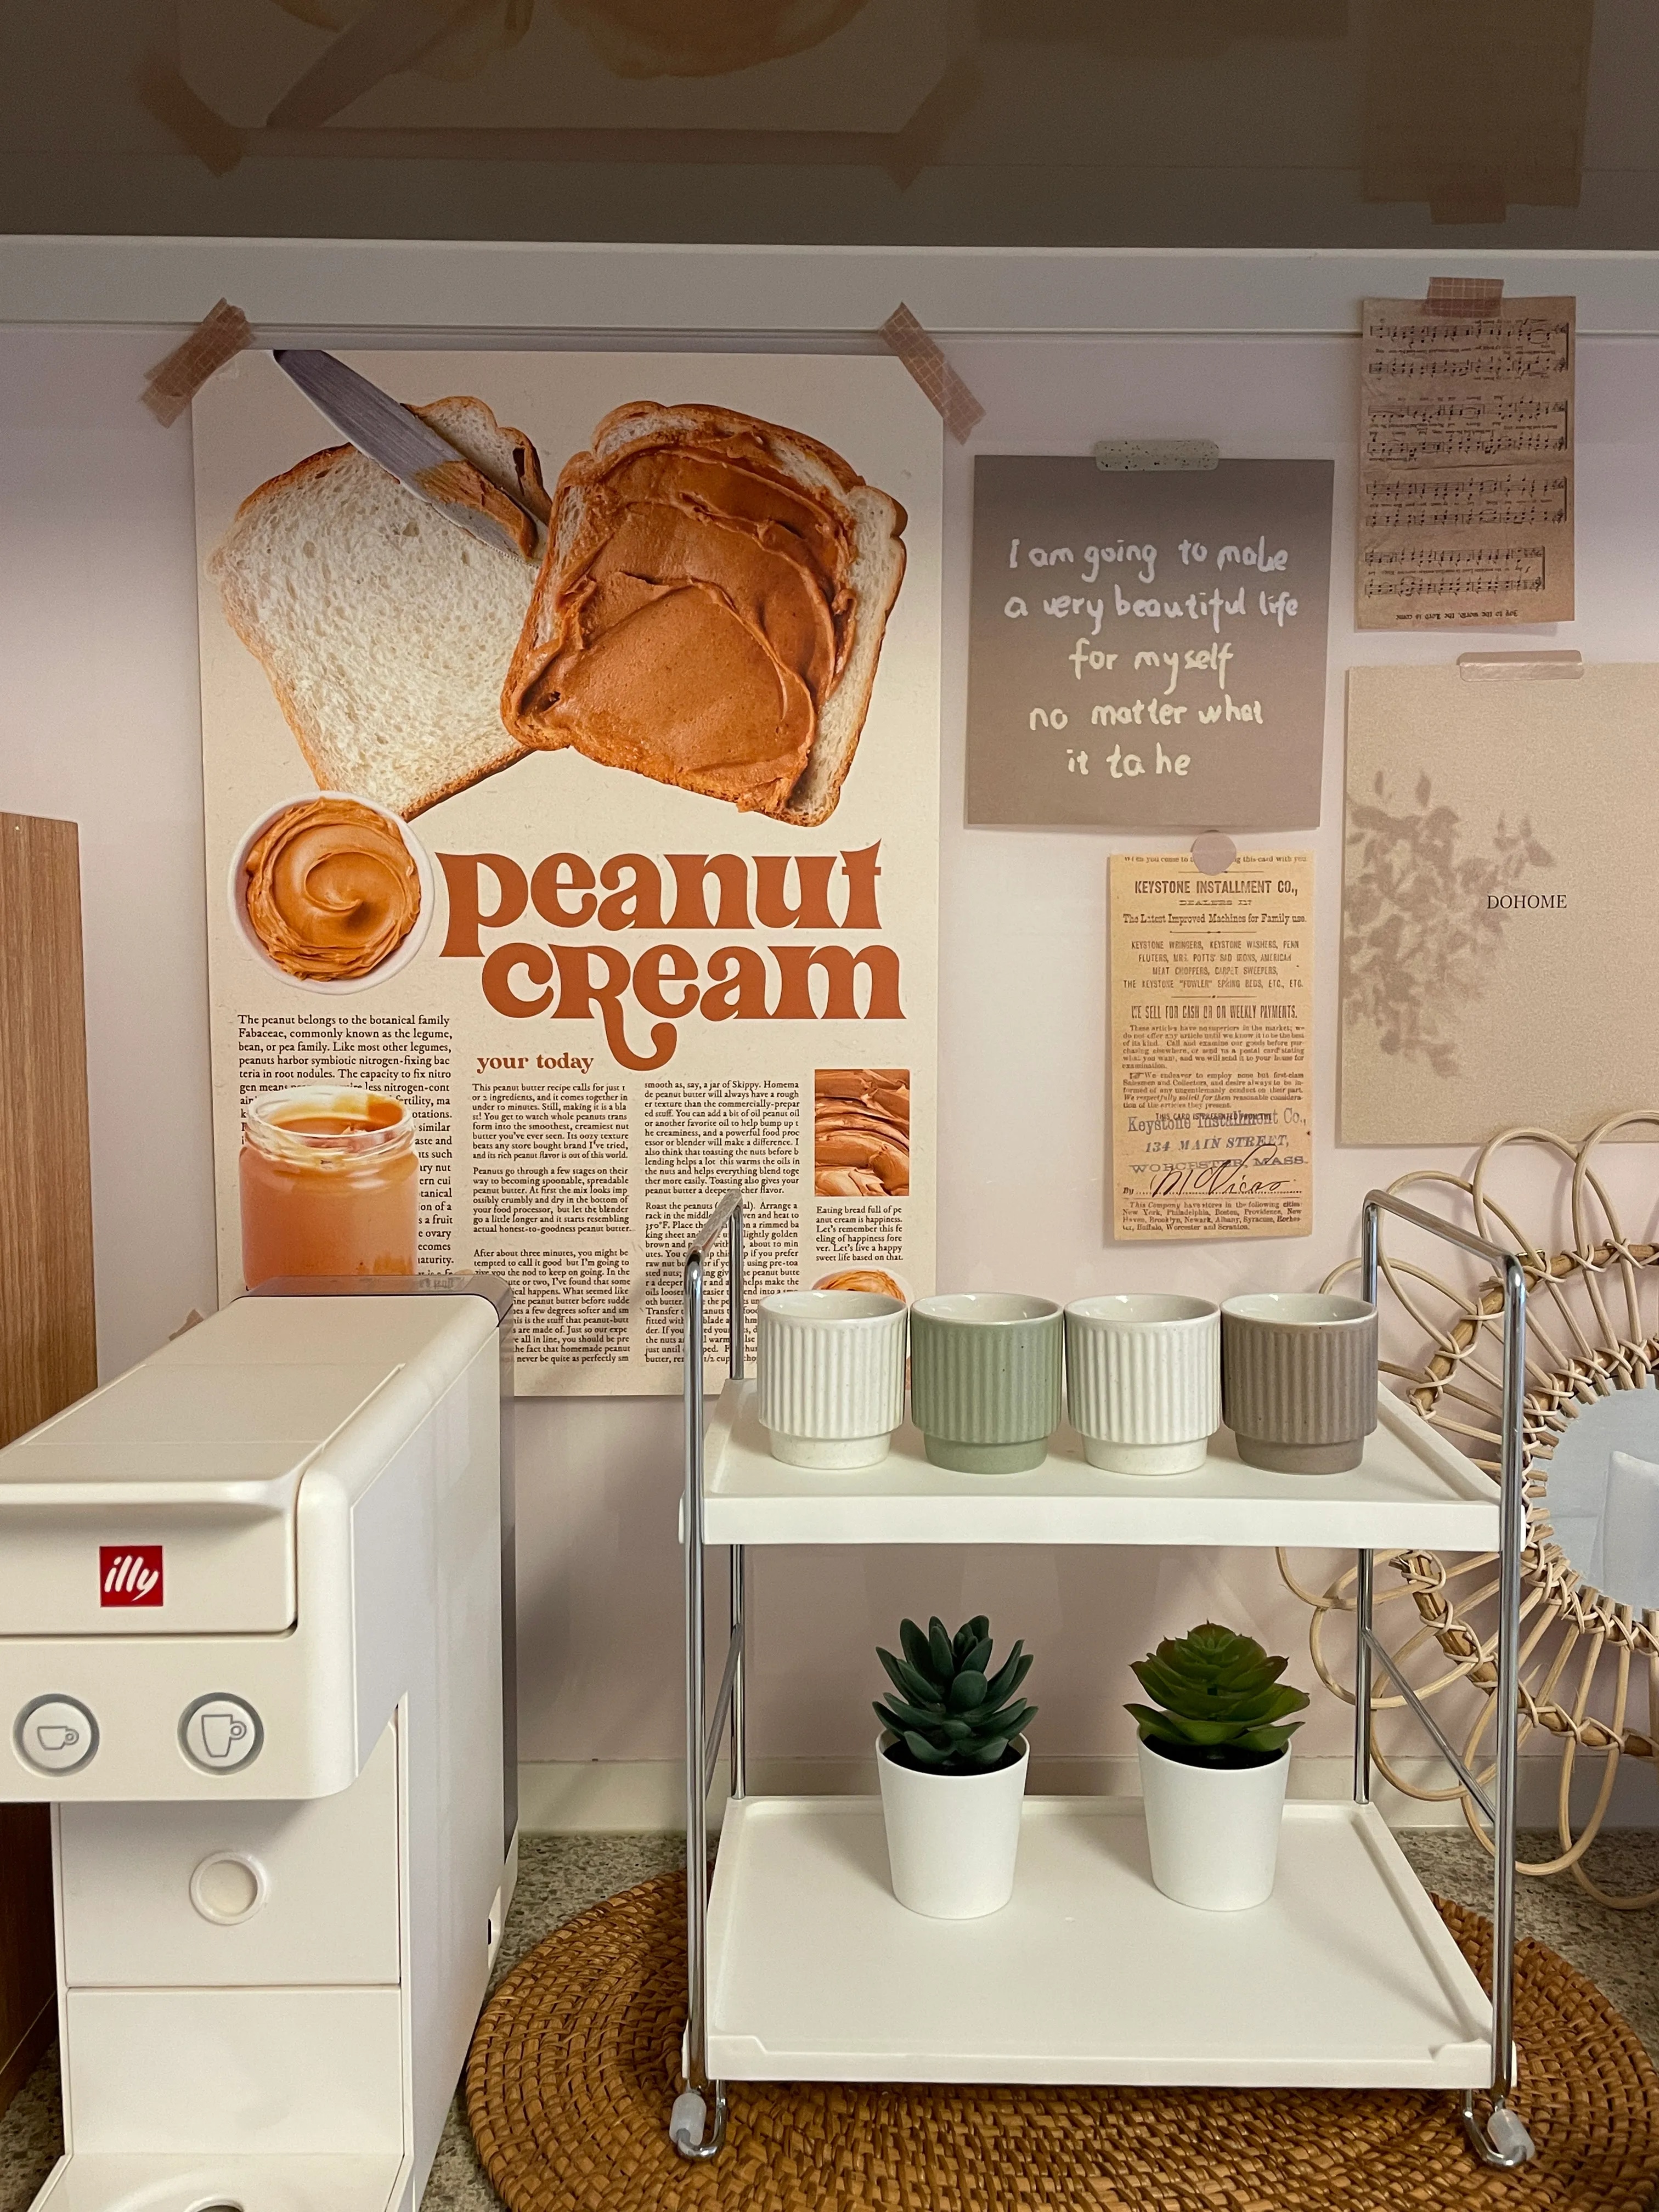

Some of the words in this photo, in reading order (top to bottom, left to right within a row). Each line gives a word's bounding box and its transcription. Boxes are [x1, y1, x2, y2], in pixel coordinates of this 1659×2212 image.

[1009, 538, 1020, 569] I
[1029, 546, 1074, 567] am
[1081, 540, 1157, 583] going
[1178, 539, 1207, 565] to
[1004, 597, 1028, 618] a
[1043, 595, 1104, 635] very
[1115, 585, 1245, 634] beautiful
[1259, 591, 1299, 628] life
[1068, 638, 1119, 680] for
[1029, 707, 1068, 731] no
[1091, 699, 1187, 726] matter
[1198, 694, 1263, 725] what
[1066, 749, 1089, 775] it
[1135, 881, 1190, 894] KEYSTONE
[1197, 881, 1272, 894] INSTALLMENT
[1278, 881, 1297, 896] CO.,
[434, 838, 882, 957] peanut
[1487, 895, 1567, 909] DOHOME
[1123, 913, 1138, 923] The
[1141, 914, 1166, 923] Latest
[1168, 913, 1206, 926] Improved
[1209, 913, 1246, 923] Machines
[1248, 913, 1259, 923] for
[1261, 913, 1290, 926] Family
[1153, 967, 1170, 975] MEAT
[1175, 967, 1210, 975] CHOPPERS,
[1215, 967, 1238, 975] CARPET
[1243, 967, 1278, 975] SWEEPERS,
[1131, 1005, 1142, 1019] WE
[1146, 1005, 1161, 1019] SELL
[1165, 1006, 1178, 1019] FOR
[1183, 1005, 1199, 1019] CASH
[1203, 1005, 1212, 1019] OR
[1216, 1005, 1226, 1019] ON
[1230, 1005, 1256, 1019] WEEKLY
[1260, 1005, 1297, 1019] PAYMENTS.
[237, 1015, 259, 1024] The
[262, 1018, 295, 1027] peanut
[298, 1015, 336, 1027] belongs
[352, 1015, 367, 1024] the
[370, 1015, 415, 1024] botanical
[418, 1015, 450, 1027] family
[238, 1028, 287, 1039] Fabaceae,
[290, 1028, 343, 1040] commonly
[346, 1028, 379, 1038] known
[394, 1028, 410, 1038] the
[413, 1028, 453, 1040] legume,
[239, 1042, 264, 1054] bean,
[279, 1045, 295, 1054] pea
[297, 1042, 330, 1054] family.
[332, 1042, 355, 1051] Like
[382, 1042, 408, 1052] other
[410, 1042, 452, 1054] legumes,
[239, 1058, 275, 1067] peanuts
[277, 1055, 309, 1065] harbor
[311, 1055, 357, 1067] symbiotic
[359, 1055, 432, 1067] nitrogen-fixing
[434, 1056, 450, 1065] bac
[477, 1054, 528, 1074] your
[537, 1052, 594, 1074] today
[240, 1069, 261, 1077] teria
[263, 1069, 272, 1078] in
[297, 1069, 335, 1078] nodules.
[337, 1069, 358, 1078] The
[360, 1069, 399, 1081] capacity
[414, 1069, 426, 1078] fix
[428, 1069, 451, 1078] nitro
[521, 1083, 545, 1091] butter
[548, 1084, 571, 1093] recipe
[573, 1083, 590, 1091] calls
[592, 1083, 604, 1091] for
[605, 1084, 619, 1093] just
[732, 1080, 761, 1090] Skippy.
[490, 1093, 535, 1103] ingredients,
[553, 1093, 558, 1102] it
[586, 1093, 618, 1103] together
[620, 1093, 628, 1102] in
[1128, 1116, 1190, 1134] Keystone
[1146, 1142, 1170, 1153] 134
[1178, 1138, 1221, 1150] MAIN
[1226, 1135, 1289, 1148] STREET,
[1130, 1159, 1248, 1172] WORCESTER,
[1123, 1187, 1134, 1195] By
[816, 1206, 843, 1215] Eating
[866, 1215, 902, 1224] happiness.
[816, 1224, 836, 1233] Let's
[838, 1224, 877, 1233] remember
[879, 1224, 894, 1232] this
[895, 1224, 902, 1232] fe
[816, 1234, 836, 1244] eling
[837, 1234, 847, 1242] of
[847, 1234, 884, 1244] happiness
[855, 1243, 870, 1251] live
[878, 1243, 902, 1253] happy
[104, 1555, 159, 1601] illy
